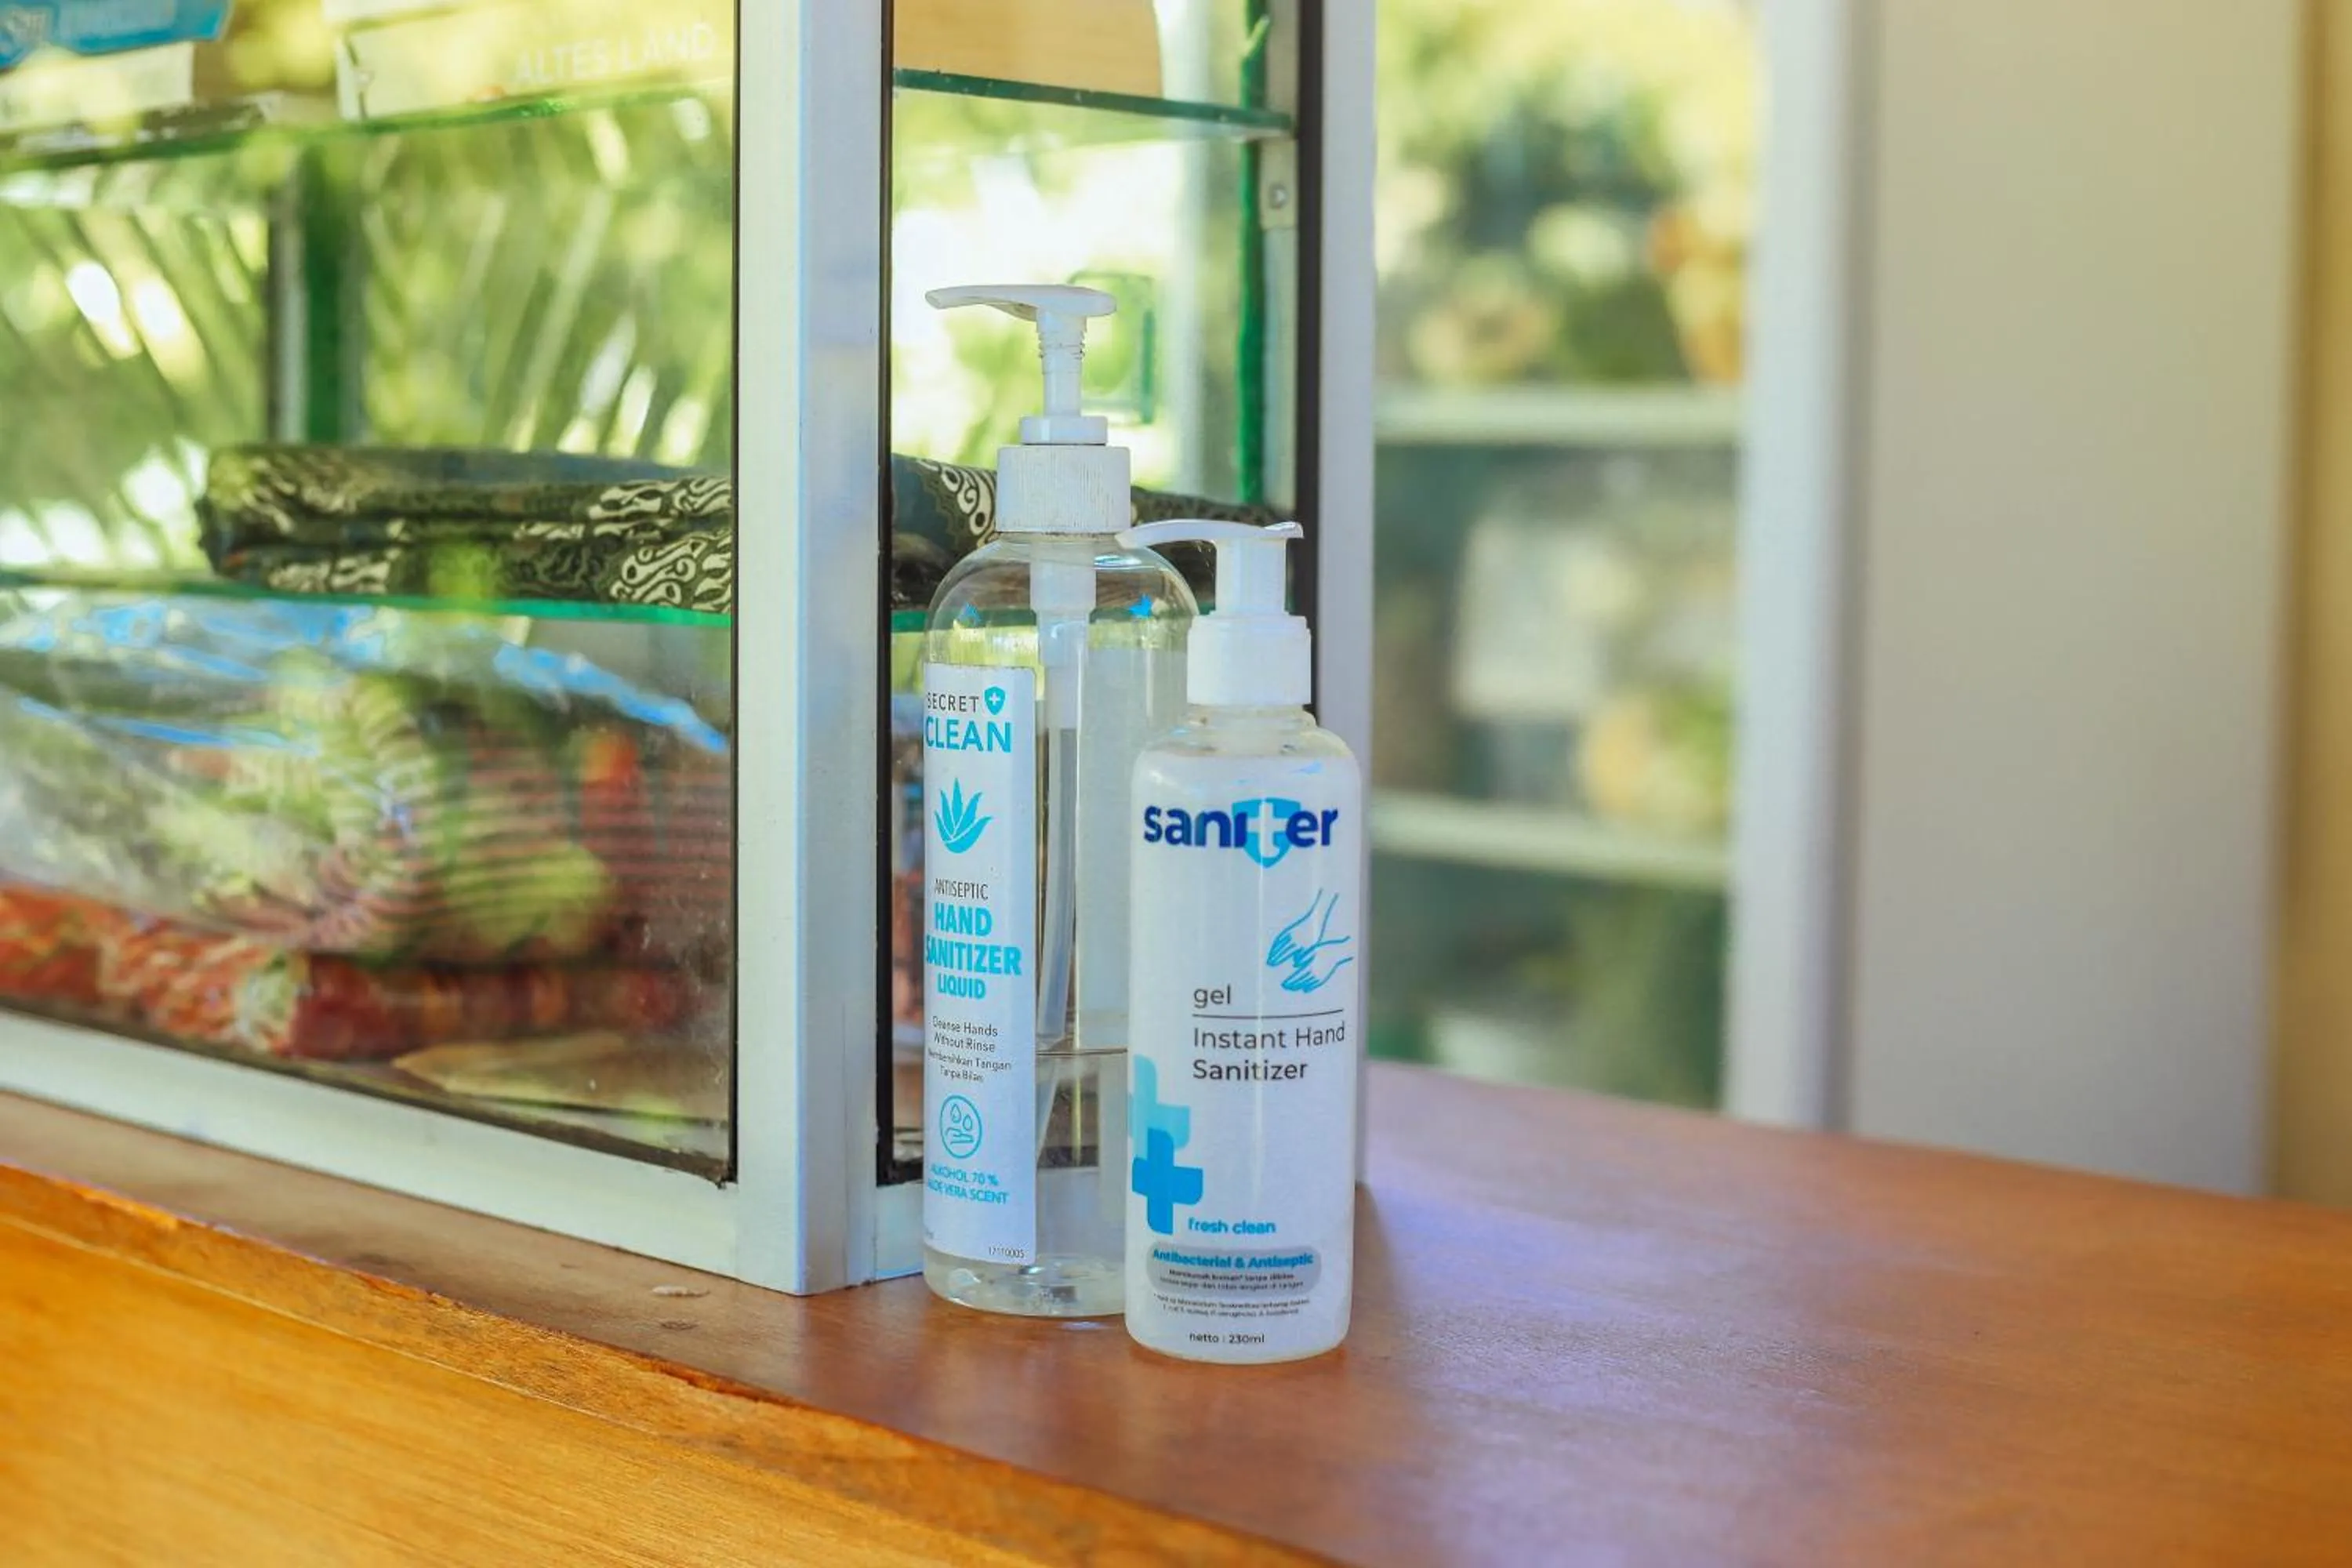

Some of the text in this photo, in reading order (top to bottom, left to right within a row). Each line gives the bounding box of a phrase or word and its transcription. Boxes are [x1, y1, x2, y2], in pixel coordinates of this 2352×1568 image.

[927, 691, 979, 713] SECRET
[925, 715, 1011, 753] CLEAN
[1143, 800, 1338, 859] saniter
[935, 878, 989, 900] ANTISEPTIC
[935, 902, 993, 937] HAND
[925, 934, 1022, 975] SANITIZER
[938, 972, 986, 1000] LIQUID
[1193, 985, 1231, 1008] gel
[964, 1022, 998, 1037] Hands
[1193, 1021, 1345, 1049] Instant Hand
[966, 1037, 996, 1053] Rinse
[1192, 1058, 1308, 1081] Sanitizer
[969, 1188, 1010, 1205] SCENT
[1189, 1217, 1276, 1235] fresh clean
[1153, 1249, 1314, 1270] Antibacterial & Antiseptic
[1189, 1333, 1219, 1344] netto
[1229, 1334, 1265, 1345] 230ml
